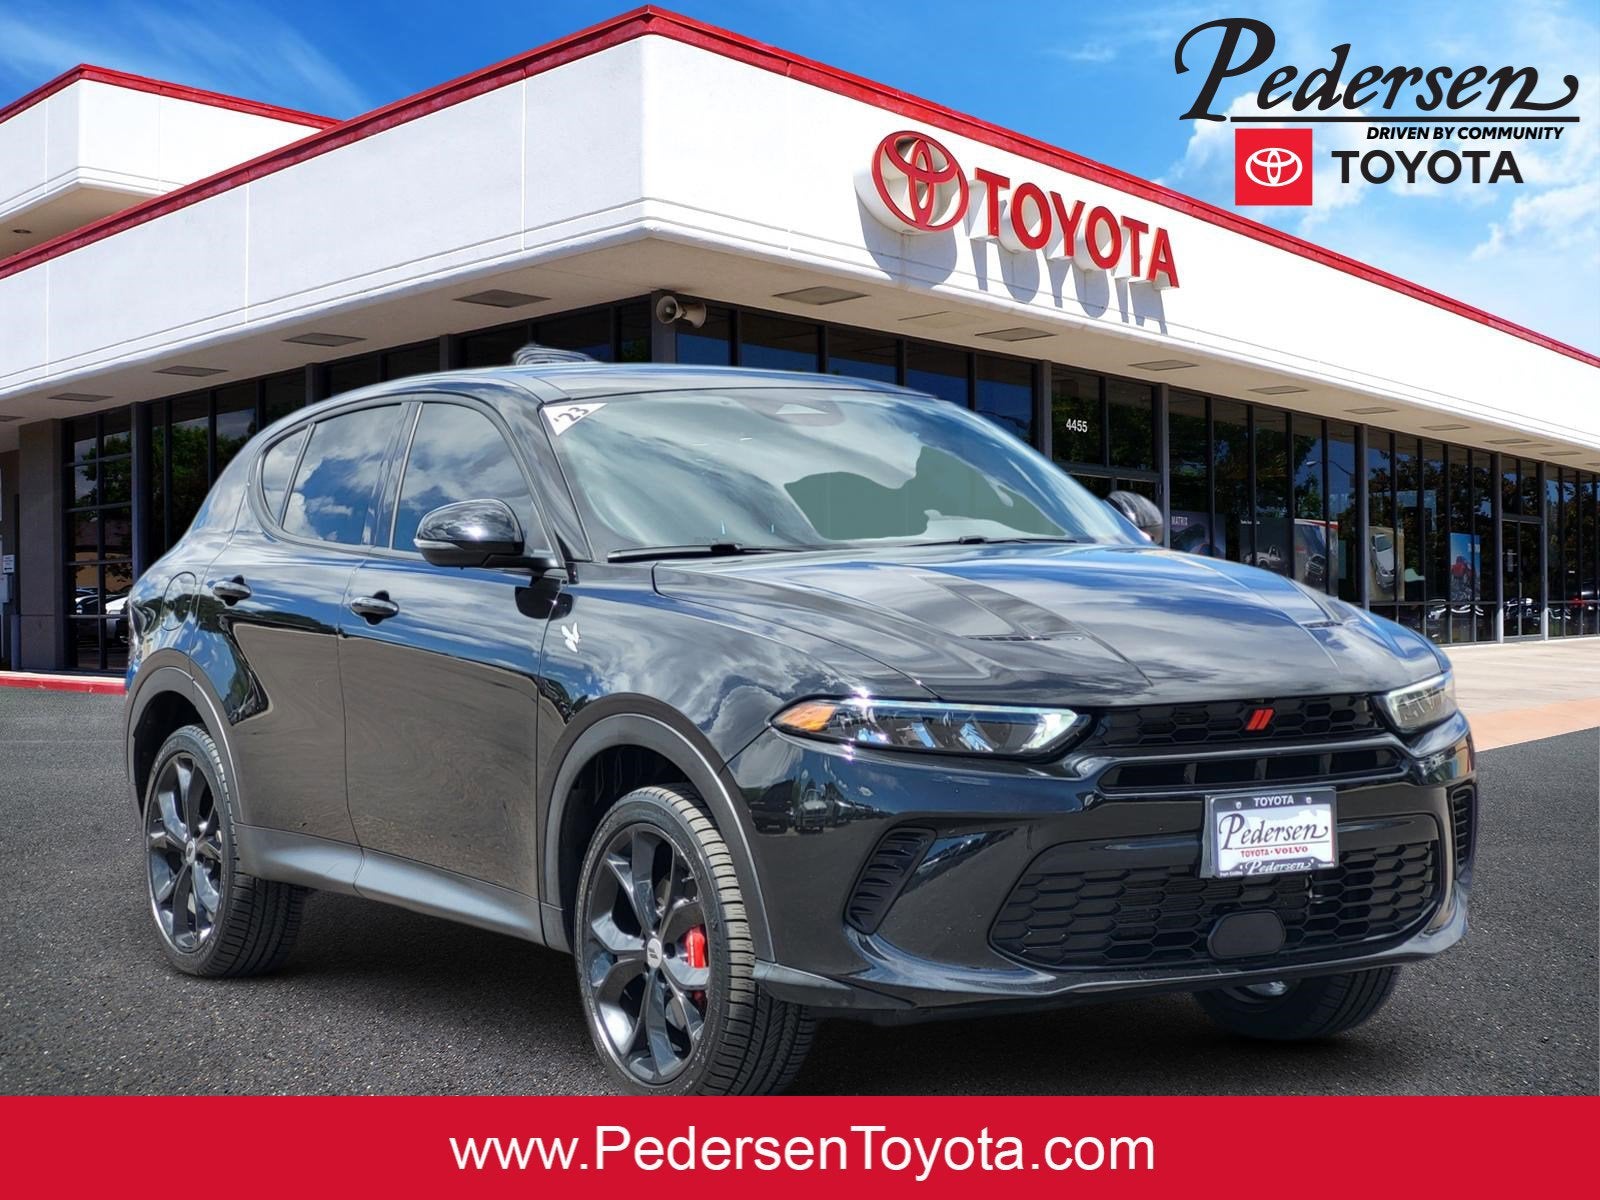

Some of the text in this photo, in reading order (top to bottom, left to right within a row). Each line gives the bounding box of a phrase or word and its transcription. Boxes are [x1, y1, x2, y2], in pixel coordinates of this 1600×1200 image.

[974, 166, 1181, 289] TOYOTA
[1065, 418, 1088, 433] 4455
[1253, 795, 1294, 808] TOYOTA
[1218, 812, 1329, 850] Pedersen
[1241, 846, 1308, 858] TOYOTA VOLVO
[1245, 860, 1312, 876] Pedersen
